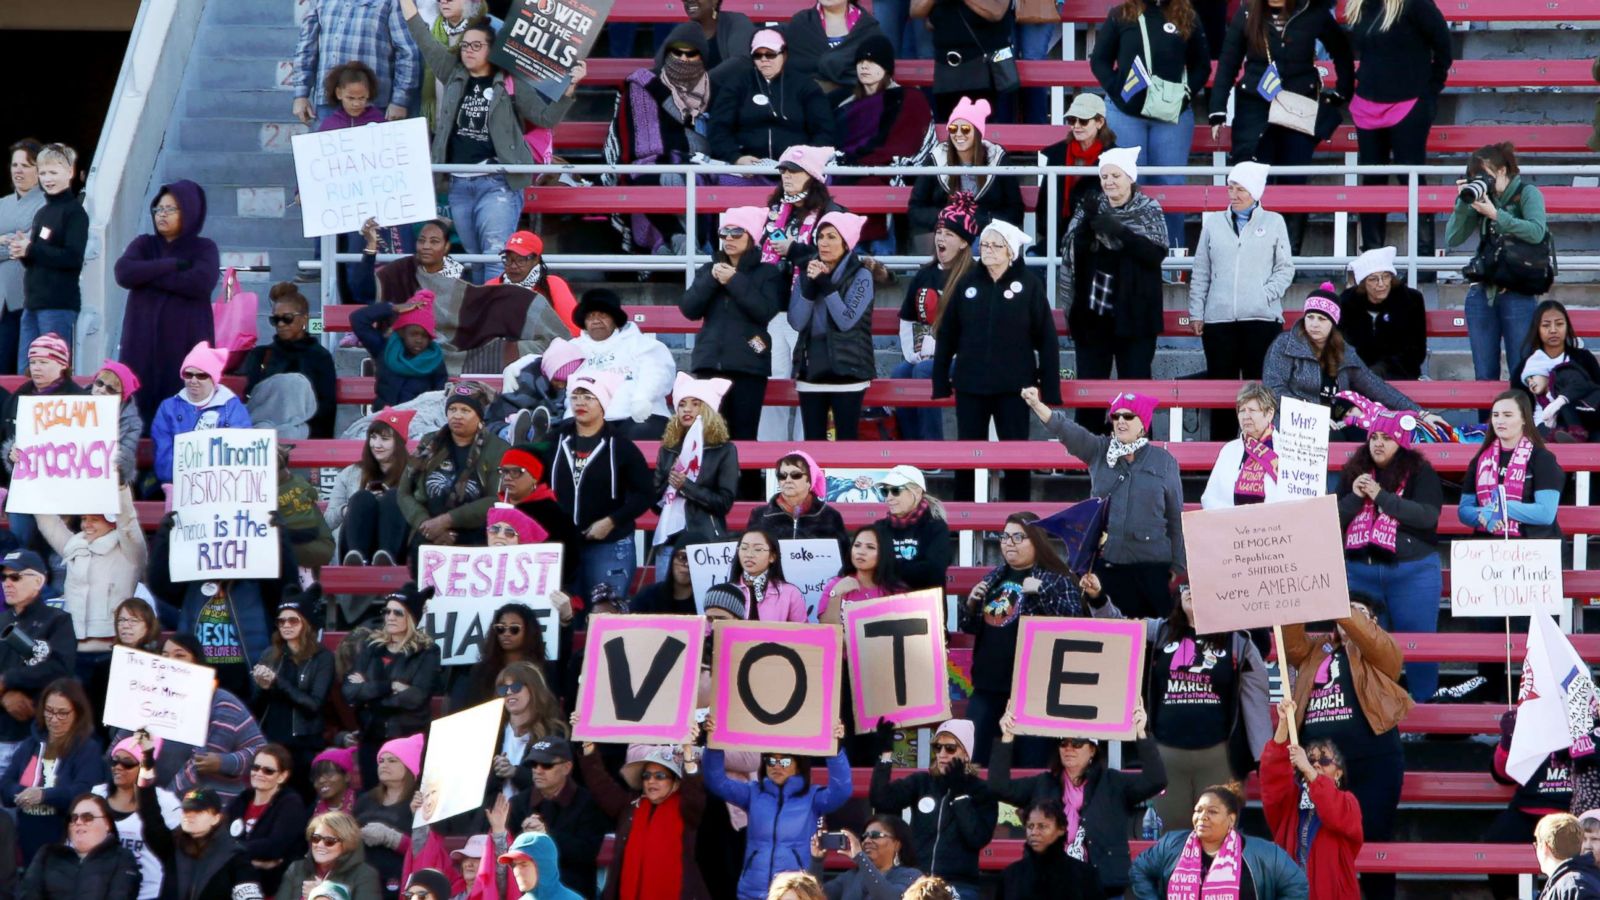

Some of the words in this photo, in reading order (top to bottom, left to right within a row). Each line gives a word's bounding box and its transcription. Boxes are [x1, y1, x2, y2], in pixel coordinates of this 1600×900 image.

[531, 12, 549, 28] TO
[549, 21, 573, 41] THE
[509, 17, 578, 68] POLLS
[318, 129, 355, 157] BE
[309, 146, 410, 181] CHANGE
[370, 171, 408, 195] FOR
[321, 193, 417, 230] OFFICE
[312, 322, 322, 331] 23
[32, 399, 98, 434] RECLAIM
[1291, 412, 1317, 430] WHY?
[13, 441, 116, 480] DEMOCRACY
[1291, 469, 1320, 485] Vegas
[180, 469, 268, 507] DESTORYING
[213, 513, 229, 538] is
[233, 509, 268, 538] the
[1235, 526, 1250, 535] We
[1268, 524, 1281, 532] not
[1233, 534, 1294, 550] DEMOCRAT
[1347, 530, 1370, 546] POLLS
[197, 539, 248, 571] RICH
[694, 547, 721, 566] Oh,
[1235, 552, 1285, 565] Republican
[1453, 542, 1484, 559] Our
[1490, 543, 1541, 562] Bodies
[422, 550, 559, 598] RESIST
[1247, 562, 1297, 577] SHITHOLES
[1481, 564, 1503, 581] Our
[1512, 564, 1556, 582] Minds
[1257, 573, 1330, 597] AMERICAN
[1241, 599, 1270, 612] VOTE
[1275, 599, 1300, 609] 2018
[1456, 586, 1484, 608] Our
[1493, 584, 1553, 606] POWER
[126, 651, 145, 666] This
[1167, 679, 1213, 693] MARCH
[1169, 671, 1211, 683] WOMEN'S
